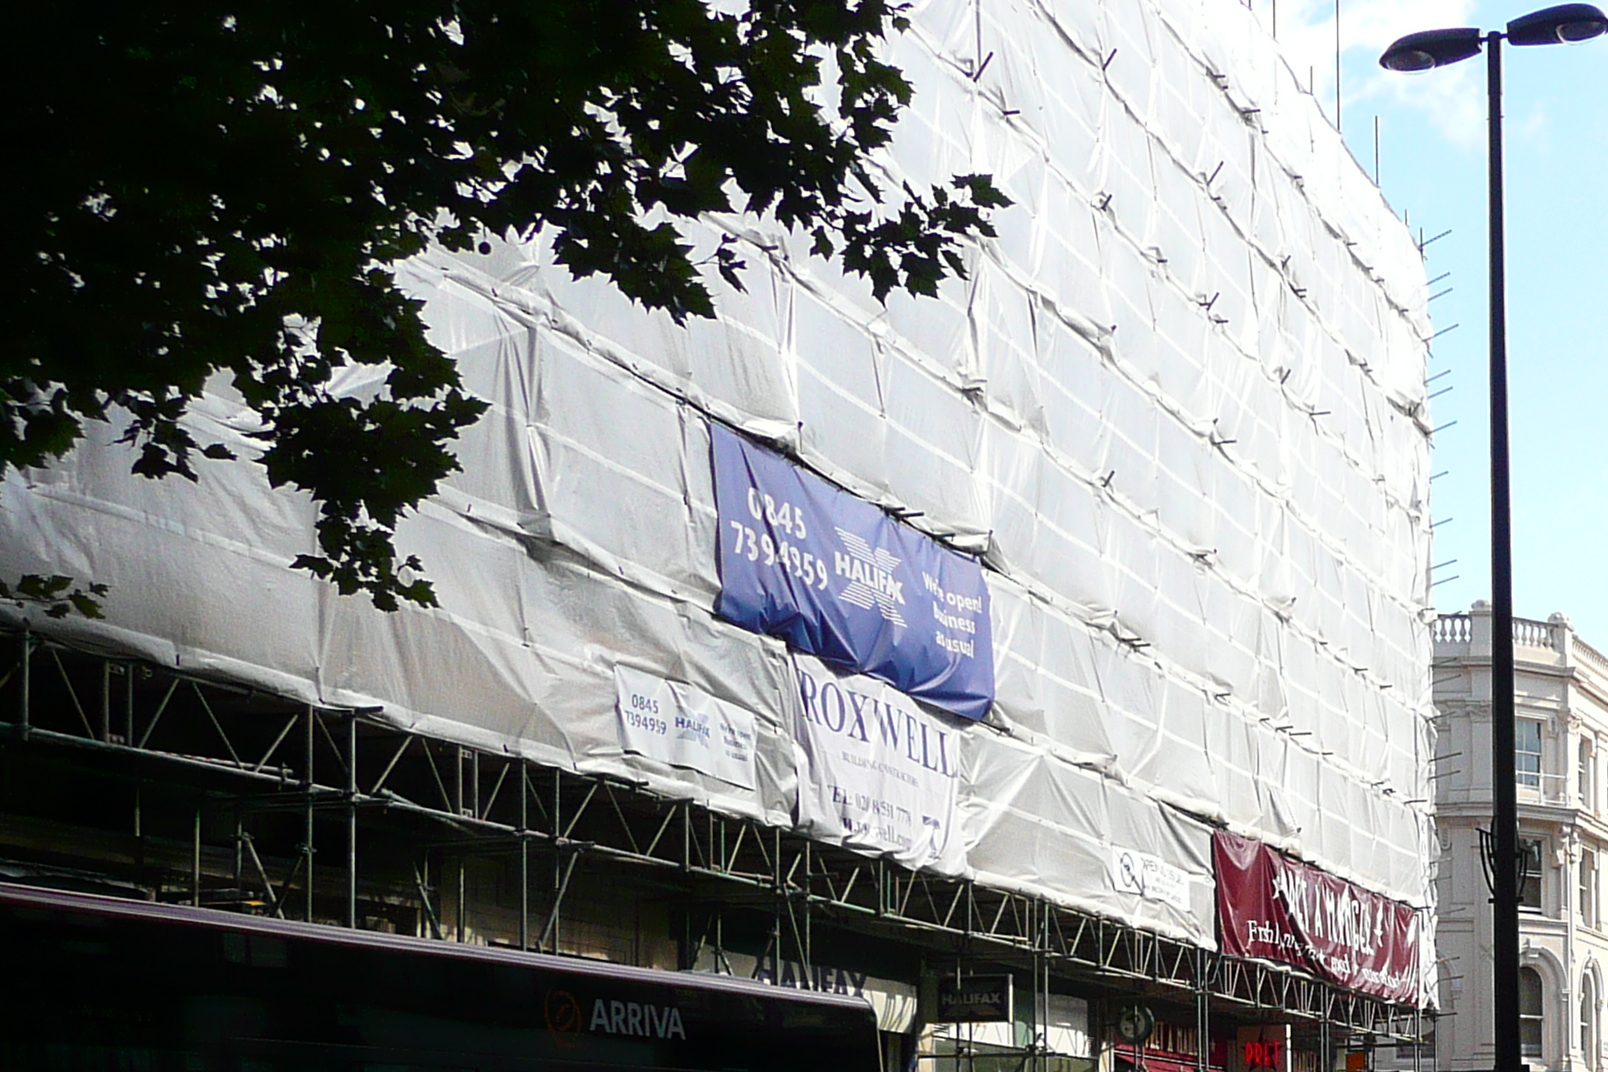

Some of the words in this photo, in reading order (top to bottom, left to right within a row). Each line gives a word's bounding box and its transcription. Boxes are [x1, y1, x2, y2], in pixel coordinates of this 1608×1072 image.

[748, 486, 806, 539] 0845
[731, 520, 828, 590] 7394959
[834, 551, 905, 604] HALIFAX
[946, 592, 982, 614] open!
[946, 636, 974, 658] usual
[632, 694, 658, 714] 0845
[624, 710, 667, 735] 7394959
[675, 716, 710, 738] HALIFAX
[799, 670, 958, 778] ROXWELL
[1314, 884, 1324, 938] A
[942, 991, 1001, 1007] HALIFAX
[589, 998, 687, 1041] ARRIVA
[1245, 1041, 1280, 1067] PRET
